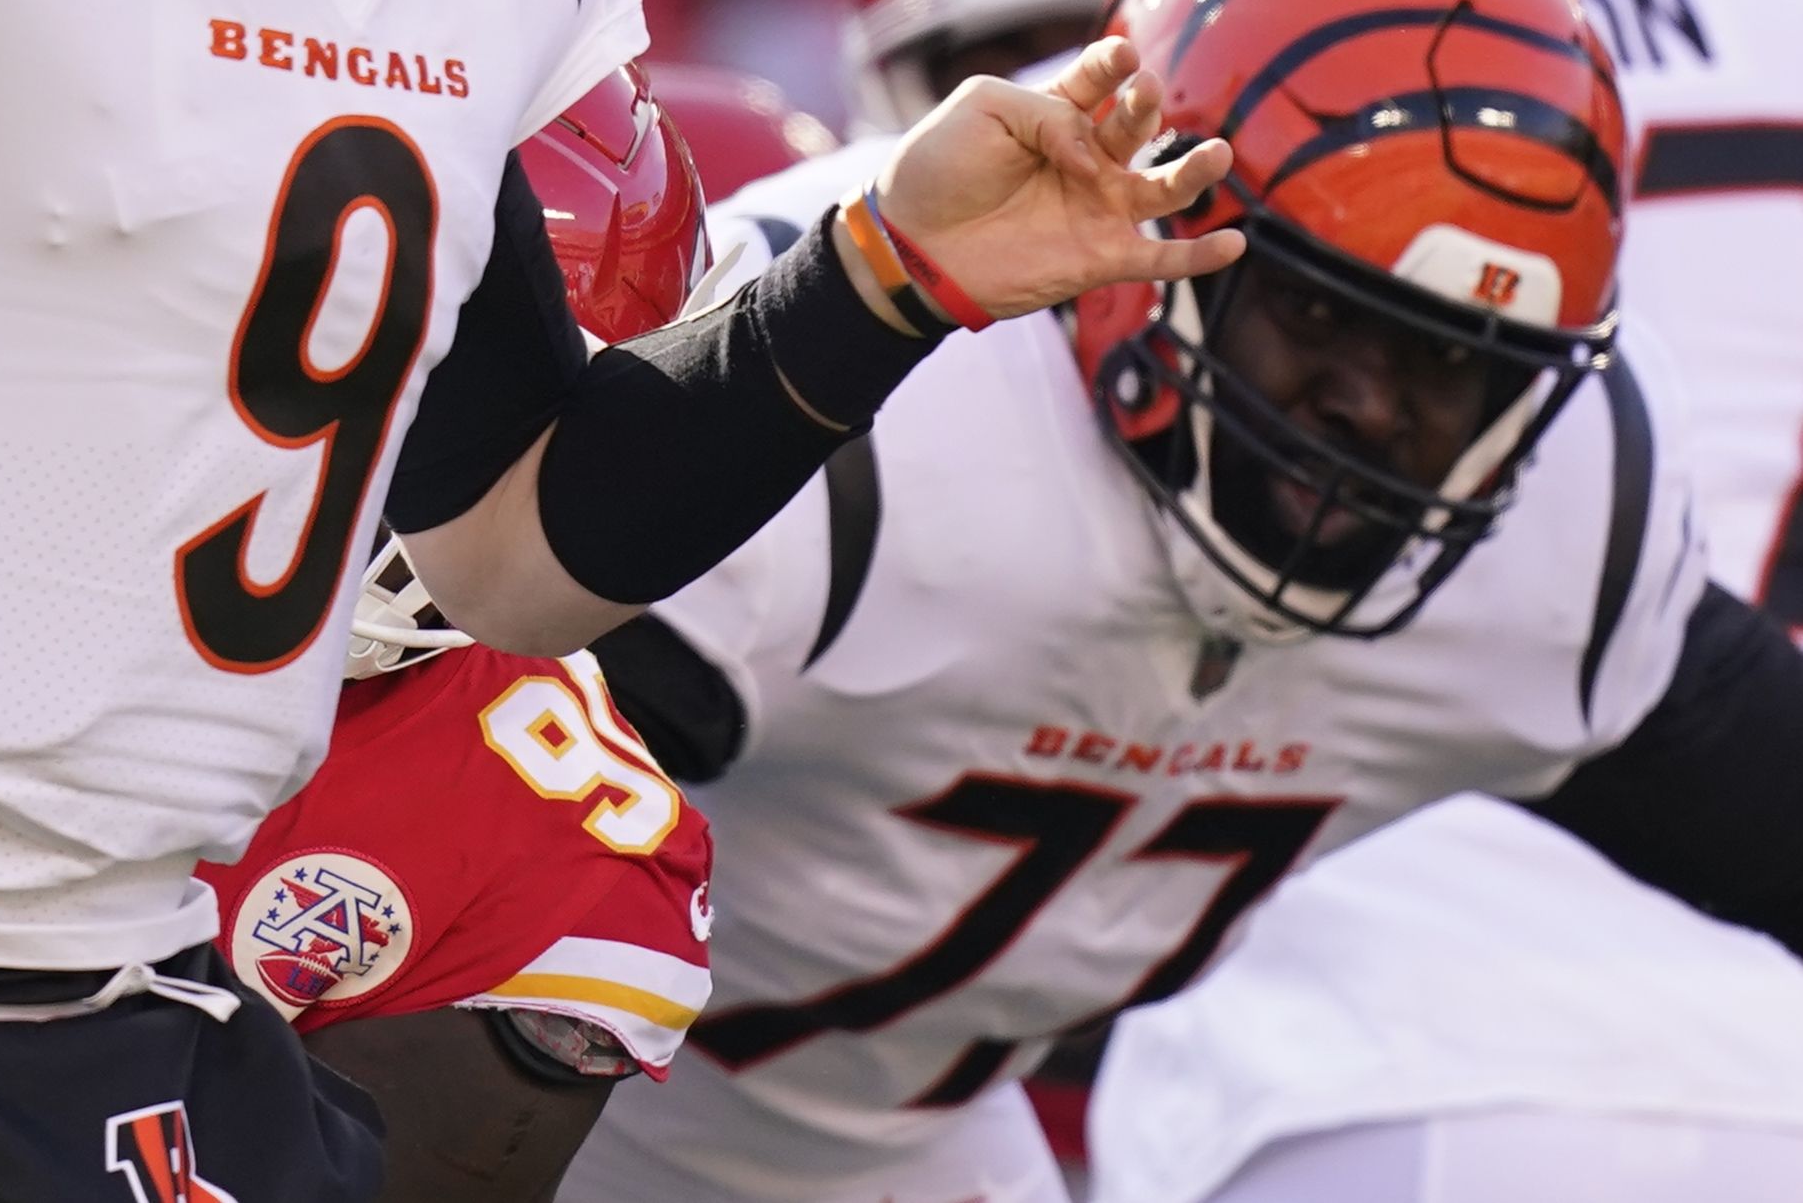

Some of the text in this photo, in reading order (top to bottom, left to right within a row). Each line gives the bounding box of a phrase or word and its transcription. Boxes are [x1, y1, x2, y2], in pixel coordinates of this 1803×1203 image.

[208, 18, 469, 99] BENGALS
[175, 115, 440, 674] 9
[1024, 725, 1311, 777] BENGALS
[684, 768, 1348, 1110] 77
